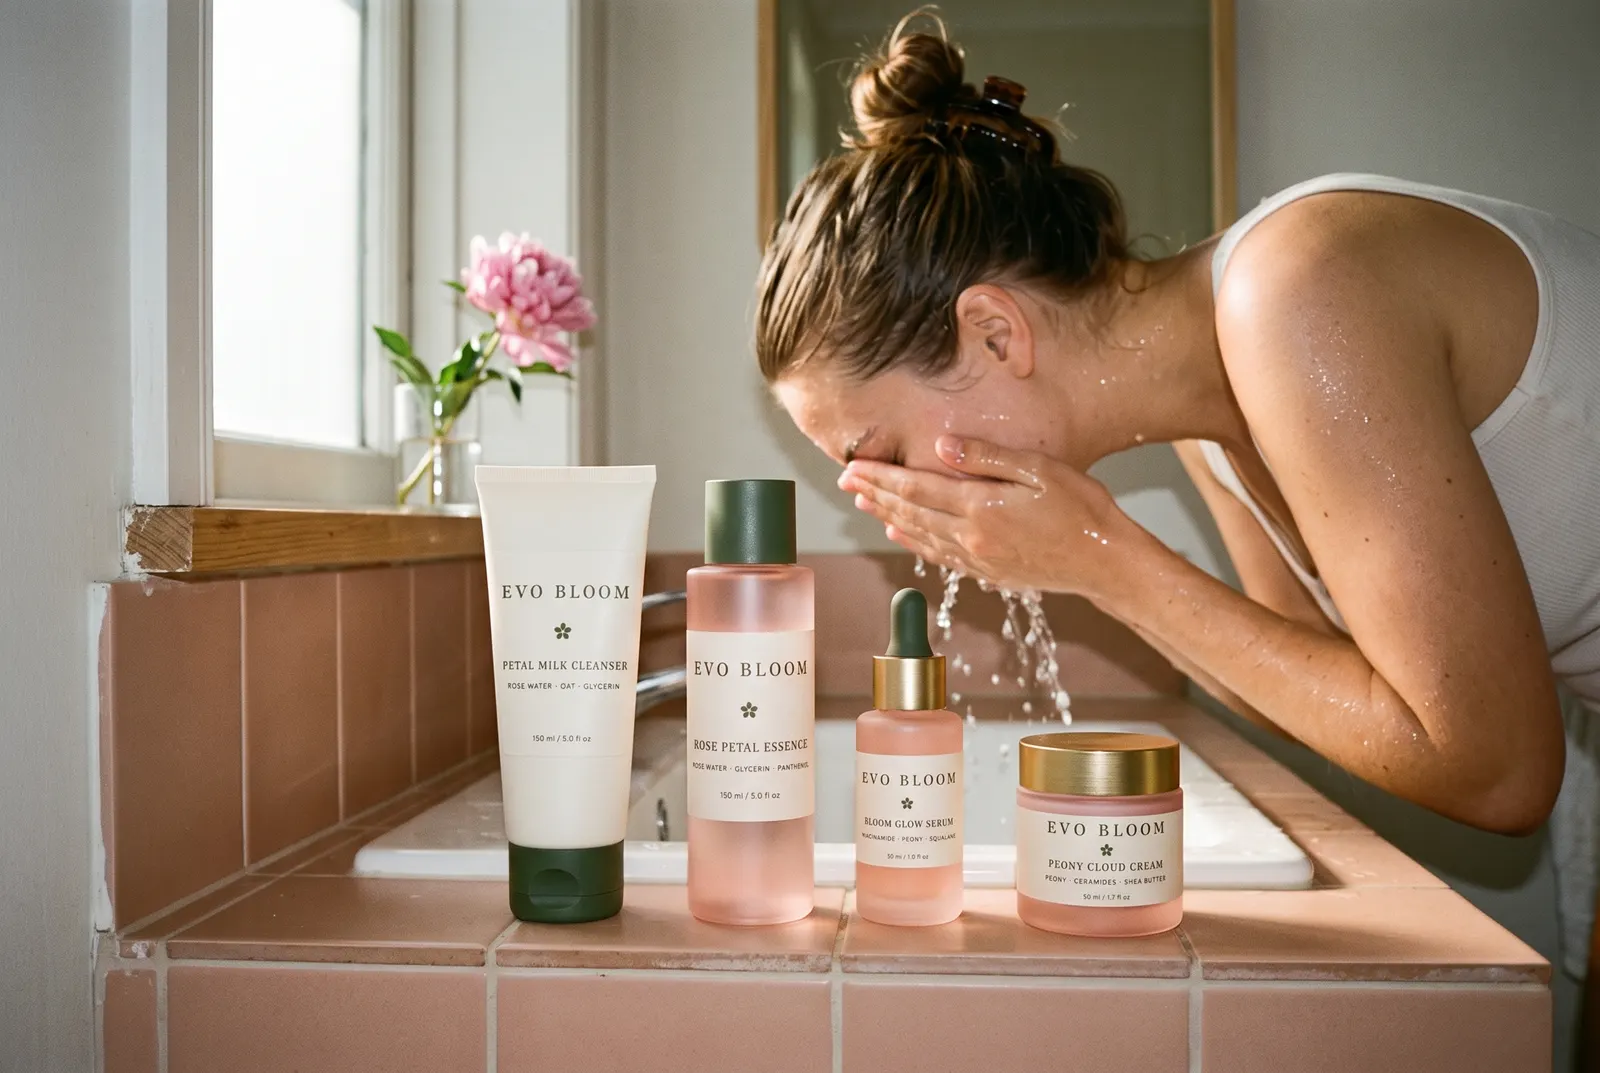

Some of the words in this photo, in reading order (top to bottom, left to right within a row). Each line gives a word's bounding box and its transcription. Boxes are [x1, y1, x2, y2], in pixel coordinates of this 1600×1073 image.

[502, 584, 543, 599] EVO
[555, 584, 630, 599] BLOOM
[502, 660, 535, 671] PETAL
[538, 660, 568, 671] MILK
[571, 660, 628, 671] CLEANSER
[694, 660, 729, 677] EVO
[740, 660, 807, 677] BLOOM
[507, 682, 526, 690] ROSE
[528, 682, 552, 690] WATER
[560, 682, 575, 690] OAT
[583, 682, 620, 690] GLYCERIN
[532, 735, 545, 743] 150
[546, 735, 556, 743] ml
[562, 735, 574, 743] 5.0
[693, 739, 718, 752] ROSE
[721, 742, 760, 753] PETAL
[764, 738, 808, 752] ESSENCE
[692, 761, 705, 770] ROSE
[705, 763, 727, 772] WATER
[734, 765, 770, 773] GLYCERIN
[862, 771, 890, 786] EVO
[899, 771, 956, 786] BLOOM
[720, 791, 733, 799] 150
[734, 792, 744, 800] ml
[751, 792, 763, 800] 5.0
[864, 816, 892, 828] BLOOM
[895, 819, 924, 828] GLOW
[925, 817, 954, 828] SERUM
[1047, 820, 1086, 836] EVO
[1098, 820, 1165, 837] BLOOM
[929, 832, 956, 842] SQUALANE
[1048, 858, 1084, 871] PEONY
[1087, 862, 1126, 872] CLOUD
[1129, 859, 1163, 871] CREAM
[1045, 874, 1067, 883] PEONY
[1073, 877, 1117, 885] CERAMIDES
[1143, 874, 1166, 884] BUTTER
